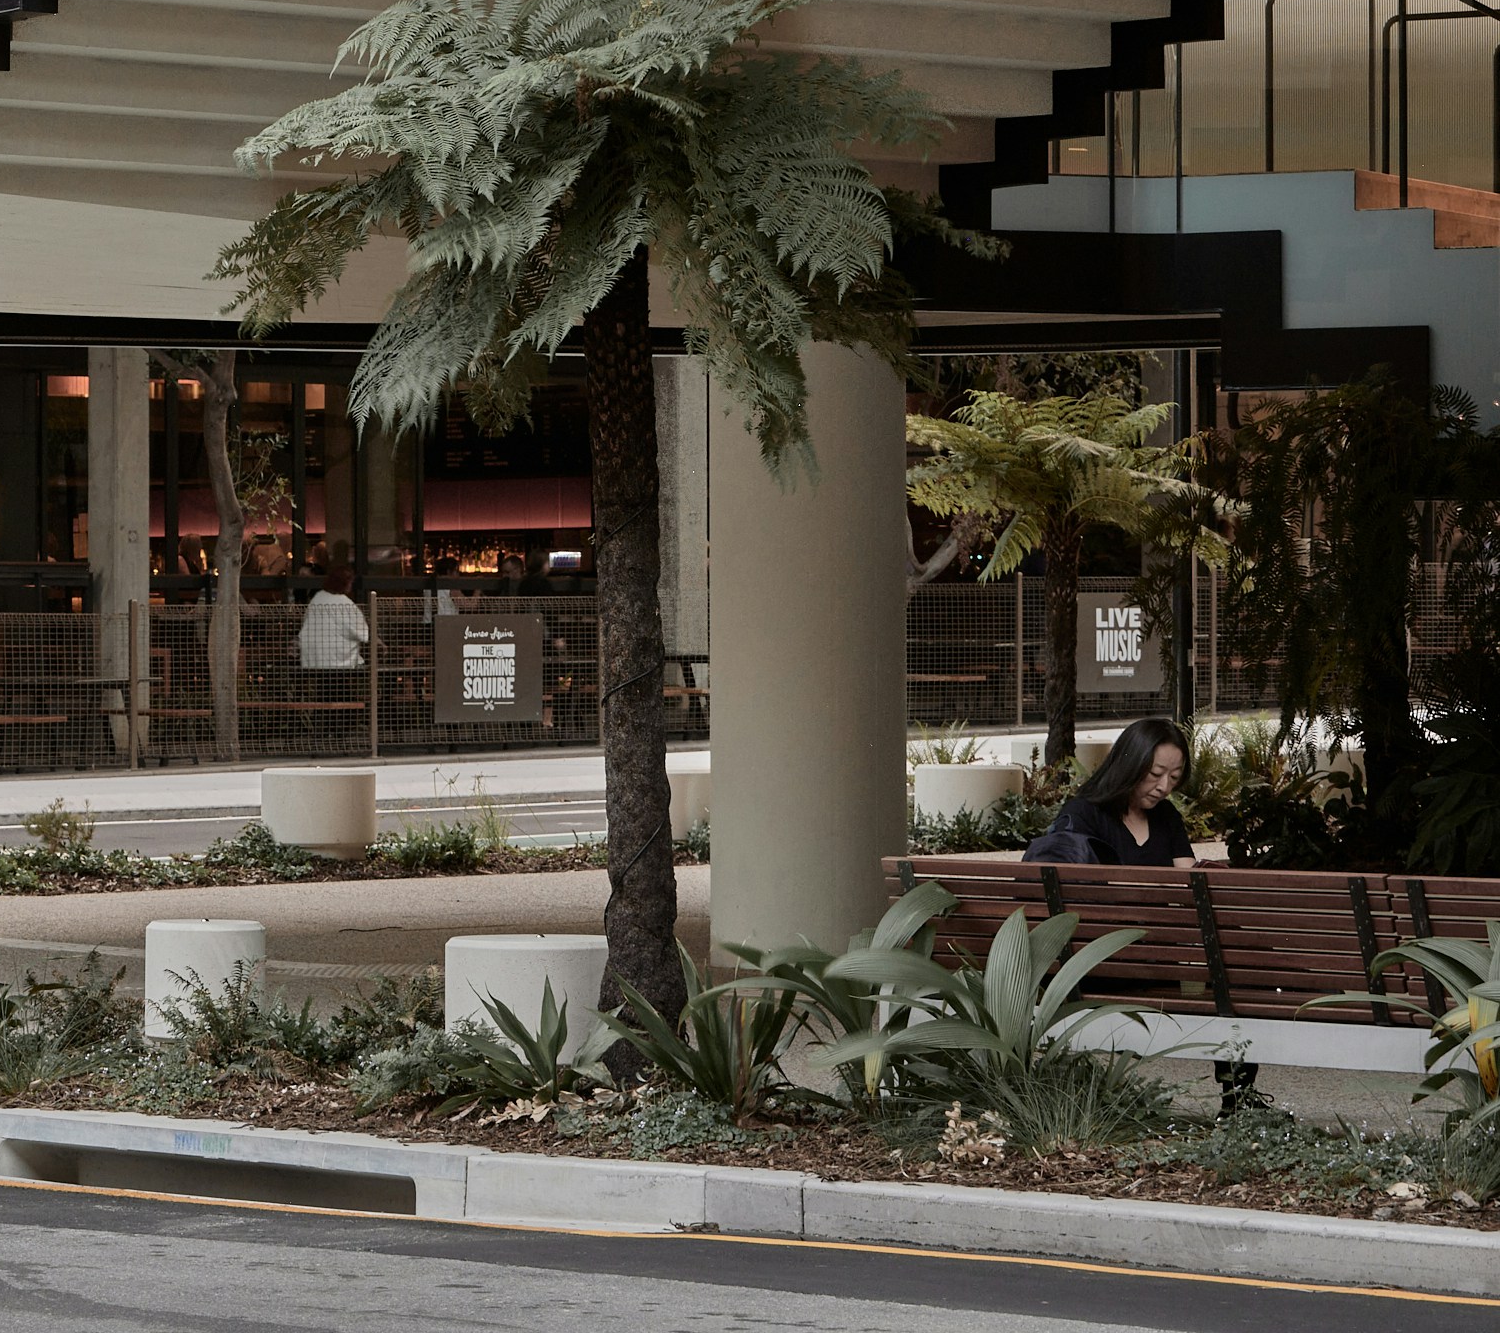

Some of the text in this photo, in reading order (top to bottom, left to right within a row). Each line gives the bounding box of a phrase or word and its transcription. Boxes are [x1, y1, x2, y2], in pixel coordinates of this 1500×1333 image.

[1095, 607, 1141, 628] LIVE
[463, 625, 514, 641] James Squire
[481, 646, 494, 656] THE
[1095, 629, 1142, 662] MUSIC
[463, 658, 515, 677] CHARMING
[463, 677, 515, 699] SQUIRE
